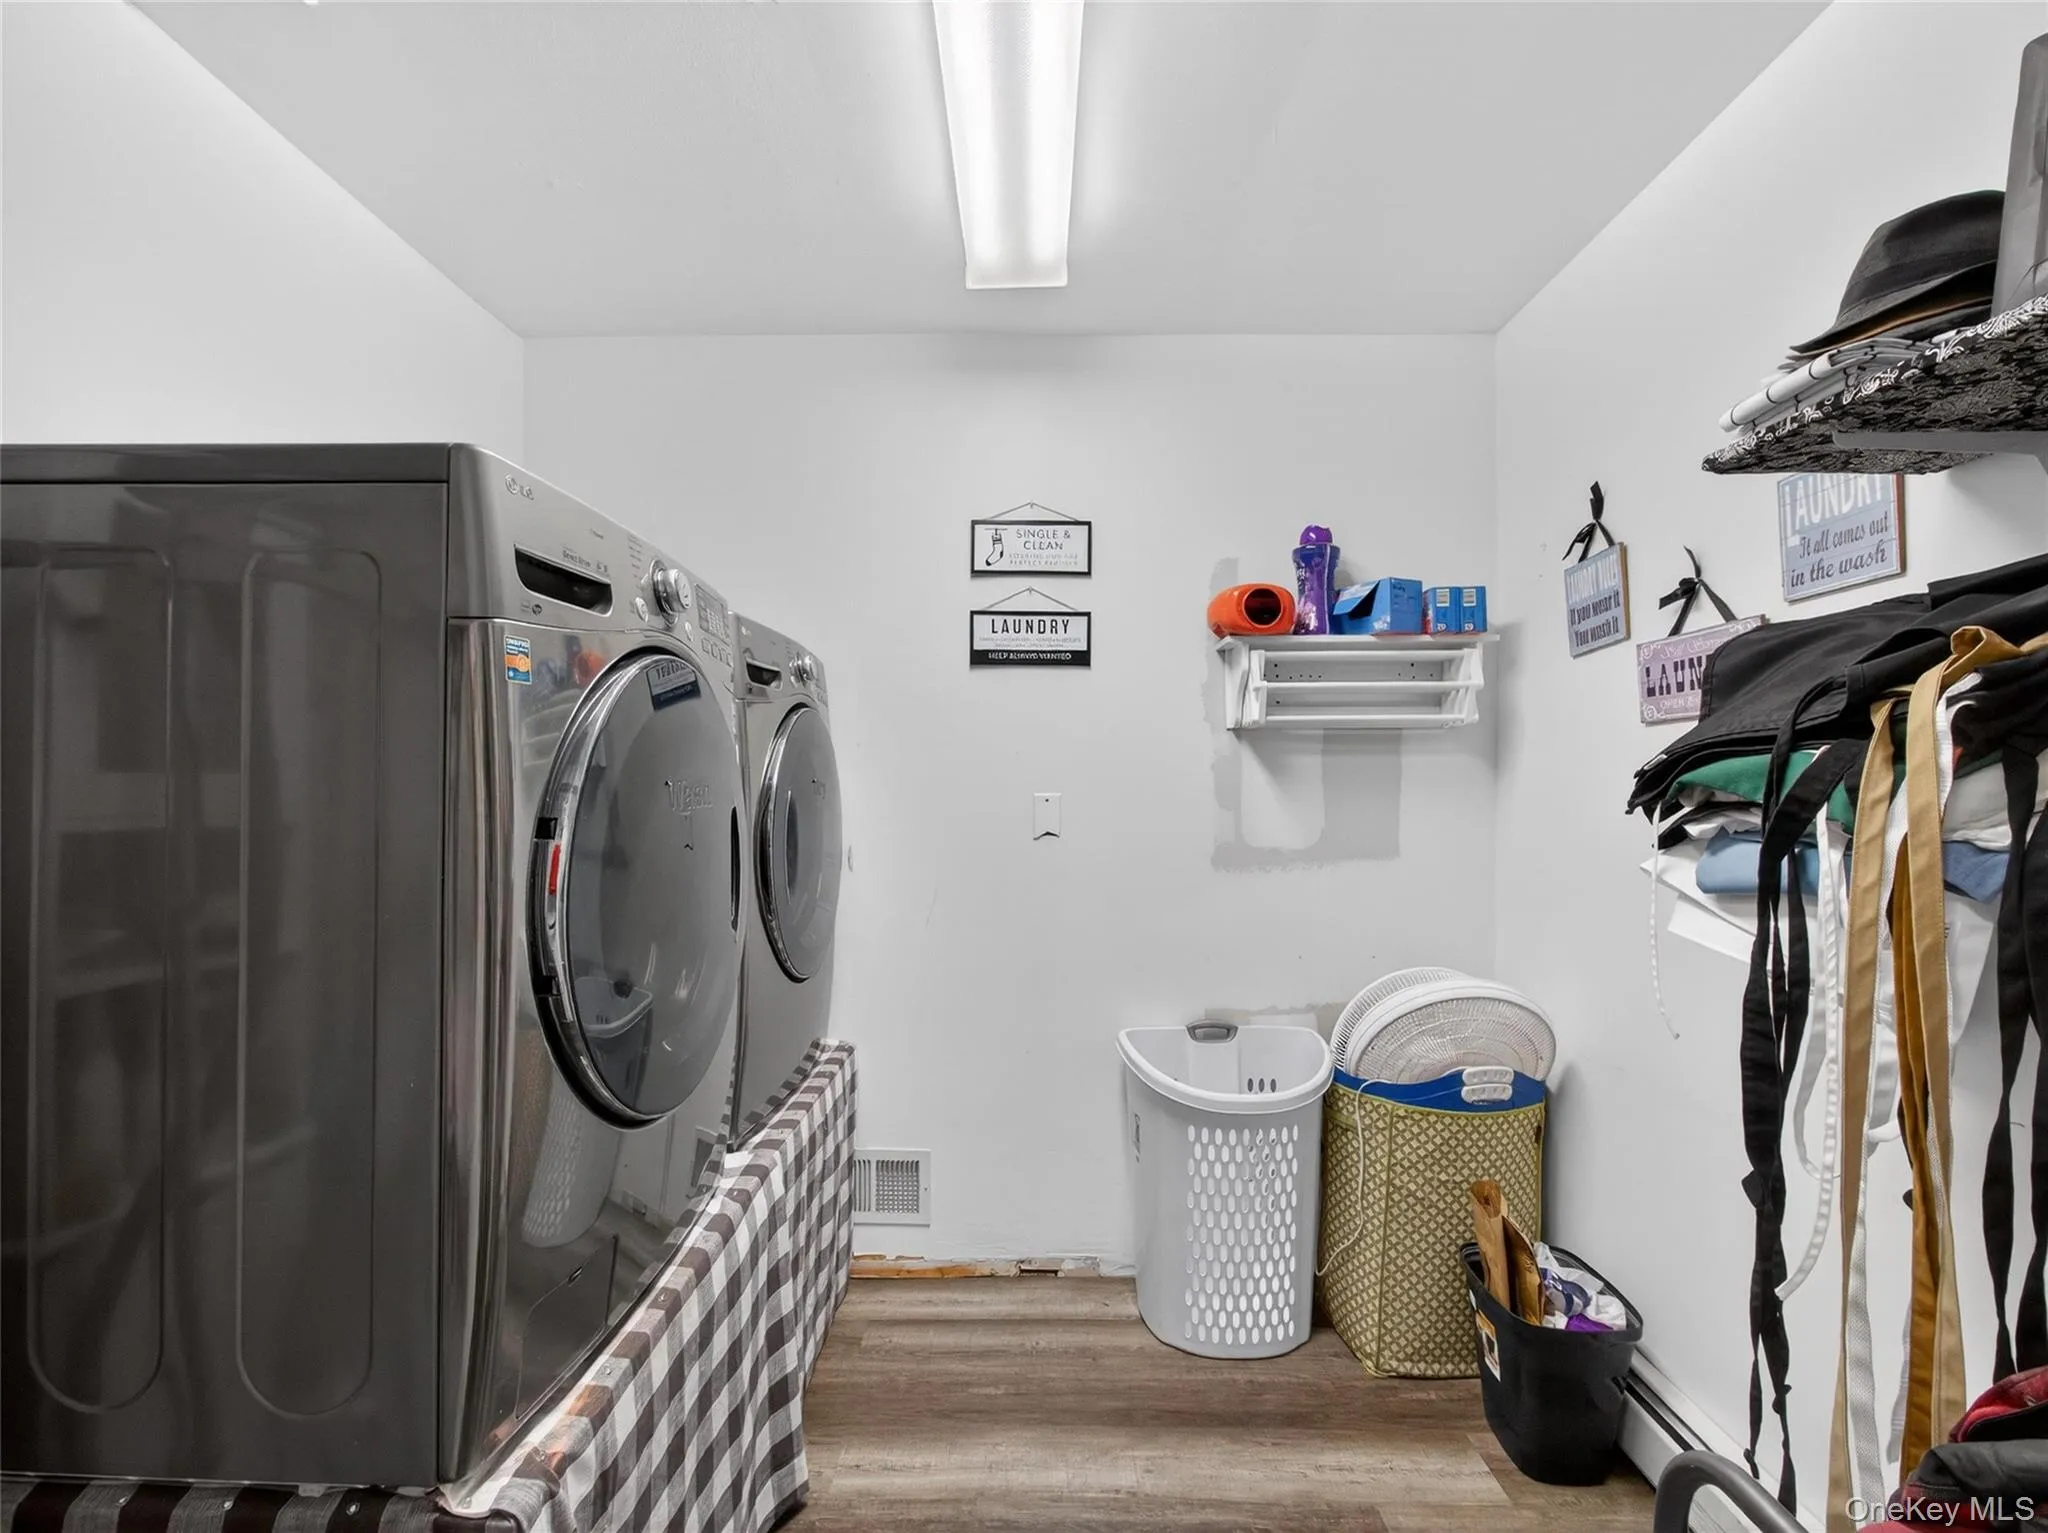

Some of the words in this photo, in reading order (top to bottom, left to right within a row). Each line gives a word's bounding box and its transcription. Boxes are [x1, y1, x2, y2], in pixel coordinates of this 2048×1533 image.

[1015, 528, 1059, 540] SINGLE
[1023, 540, 1064, 551] CLEAN
[1799, 536, 1811, 559] It
[1813, 529, 1829, 554] all
[1832, 524, 1865, 548] comes
[1869, 511, 1888, 536] out
[1791, 569, 1805, 588] in
[1810, 558, 1834, 582] the
[1838, 539, 1887, 575] wash
[991, 618, 1069, 634] LAUNDRY
[1645, 656, 1702, 697] LAUN
